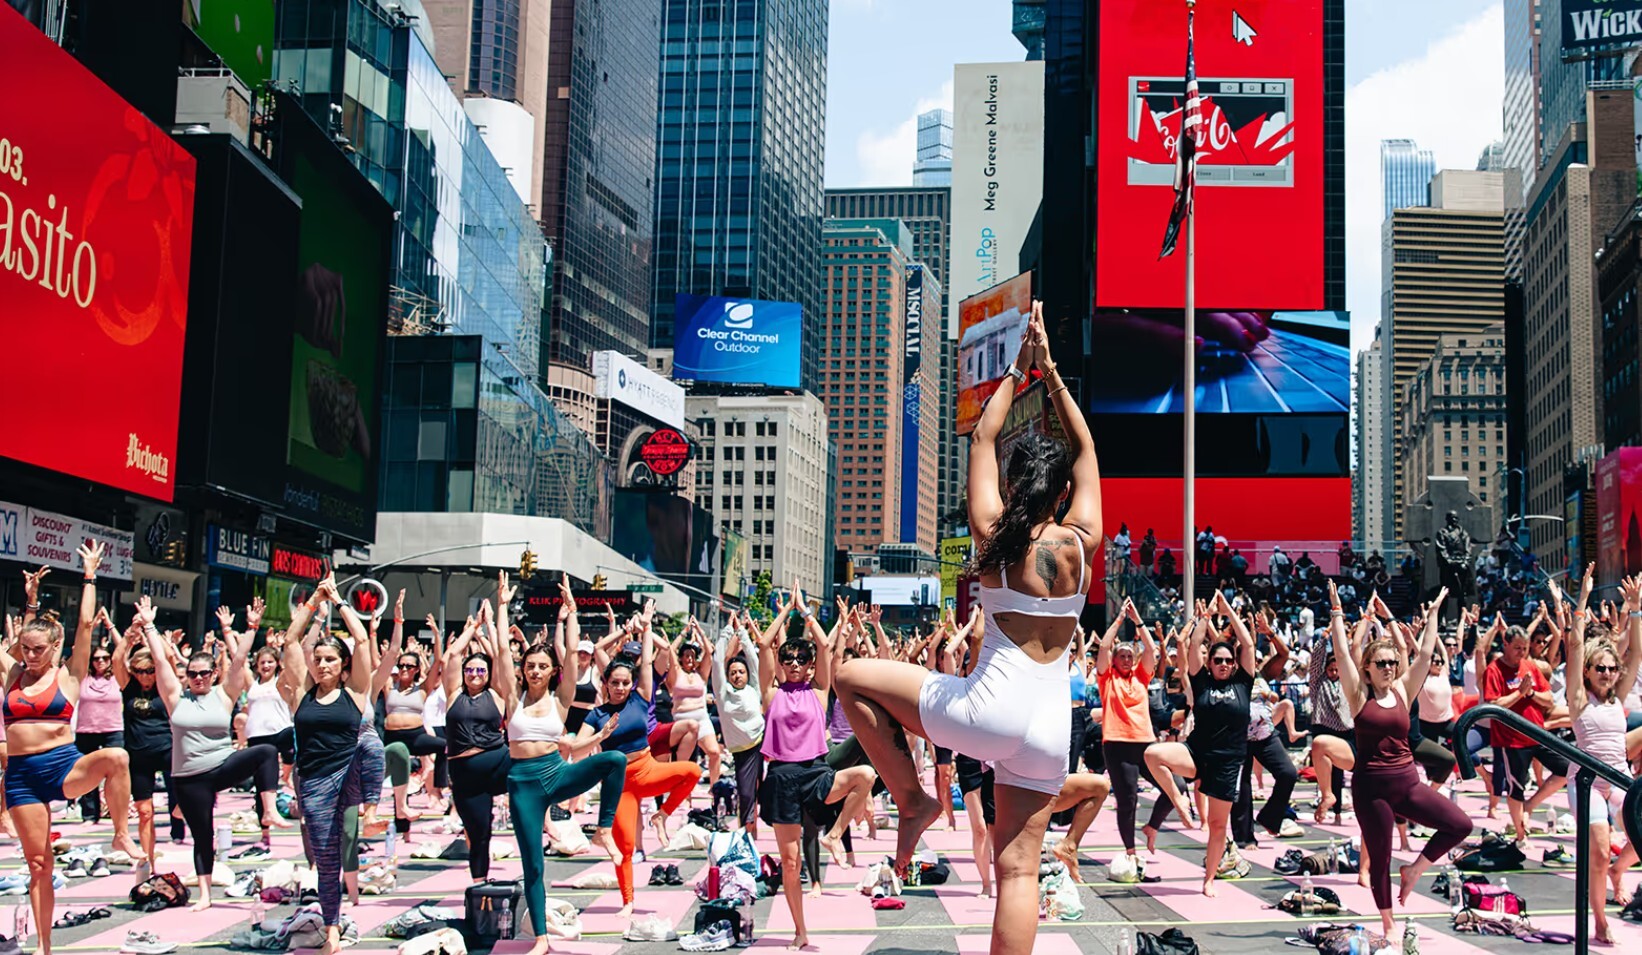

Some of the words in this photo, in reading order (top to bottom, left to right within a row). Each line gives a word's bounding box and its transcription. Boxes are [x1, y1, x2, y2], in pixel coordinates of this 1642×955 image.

[984, 75, 998, 126] Malvasi
[984, 130, 997, 178] Greene
[984, 182, 999, 211] Meg
[697, 328, 729, 340] Clear
[731, 331, 779, 343] Channel
[714, 341, 761, 353] Outdoor
[32, 515, 72, 534] DISCOUNT
[35, 531, 58, 547] GIFTS
[59, 538, 65, 547] &
[219, 528, 248, 554] BLUE
[253, 535, 271, 559] FIN
[27, 544, 72, 564] SOUVENIRS
[529, 596, 551, 606] KLIK
[552, 597, 626, 606] PHTOGRAPHY
